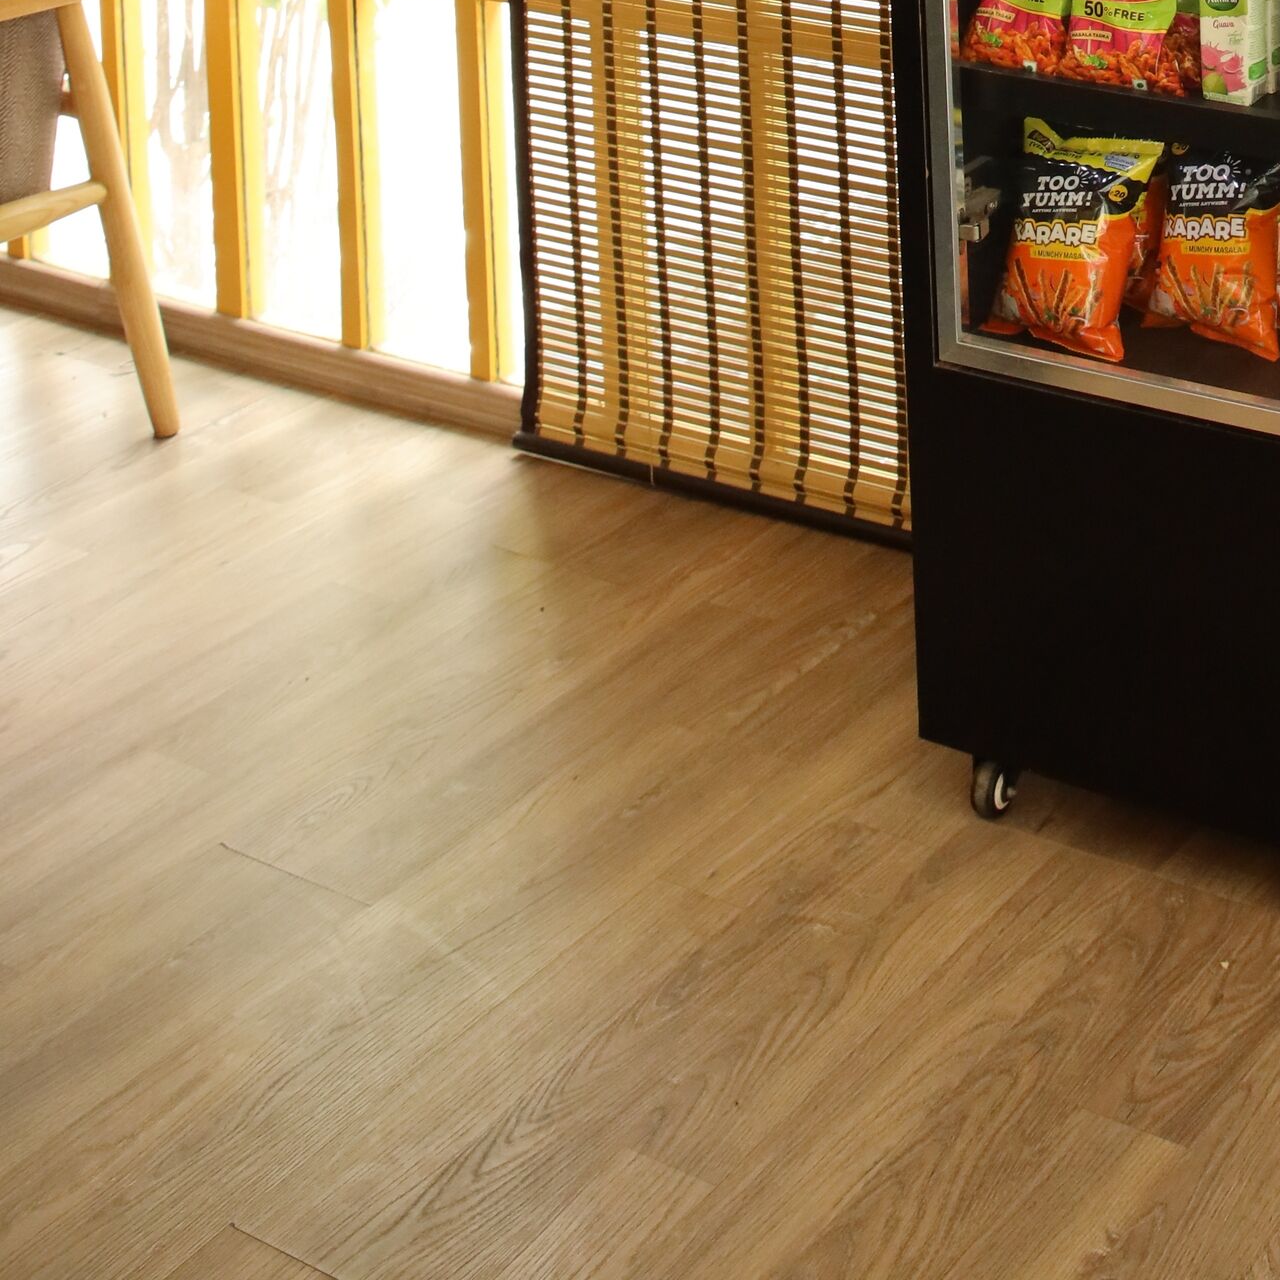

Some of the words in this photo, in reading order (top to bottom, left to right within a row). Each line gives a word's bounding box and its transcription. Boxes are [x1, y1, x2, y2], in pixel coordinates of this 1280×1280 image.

[1113, 8, 1145, 21] FREE
[1213, 20, 1234, 29] Guava
[1183, 164, 1231, 182] TOO
[1037, 175, 1080, 191] TOO
[1022, 191, 1092, 207] YUMM!
[1171, 183, 1246, 201] YUMM!
[1014, 219, 1097, 246] KARARE
[1165, 217, 1245, 241] KARARE
[1037, 250, 1063, 258] MUNCHY
[1189, 246, 1214, 254] MUNCHY
[1214, 246, 1242, 254] MASALA
